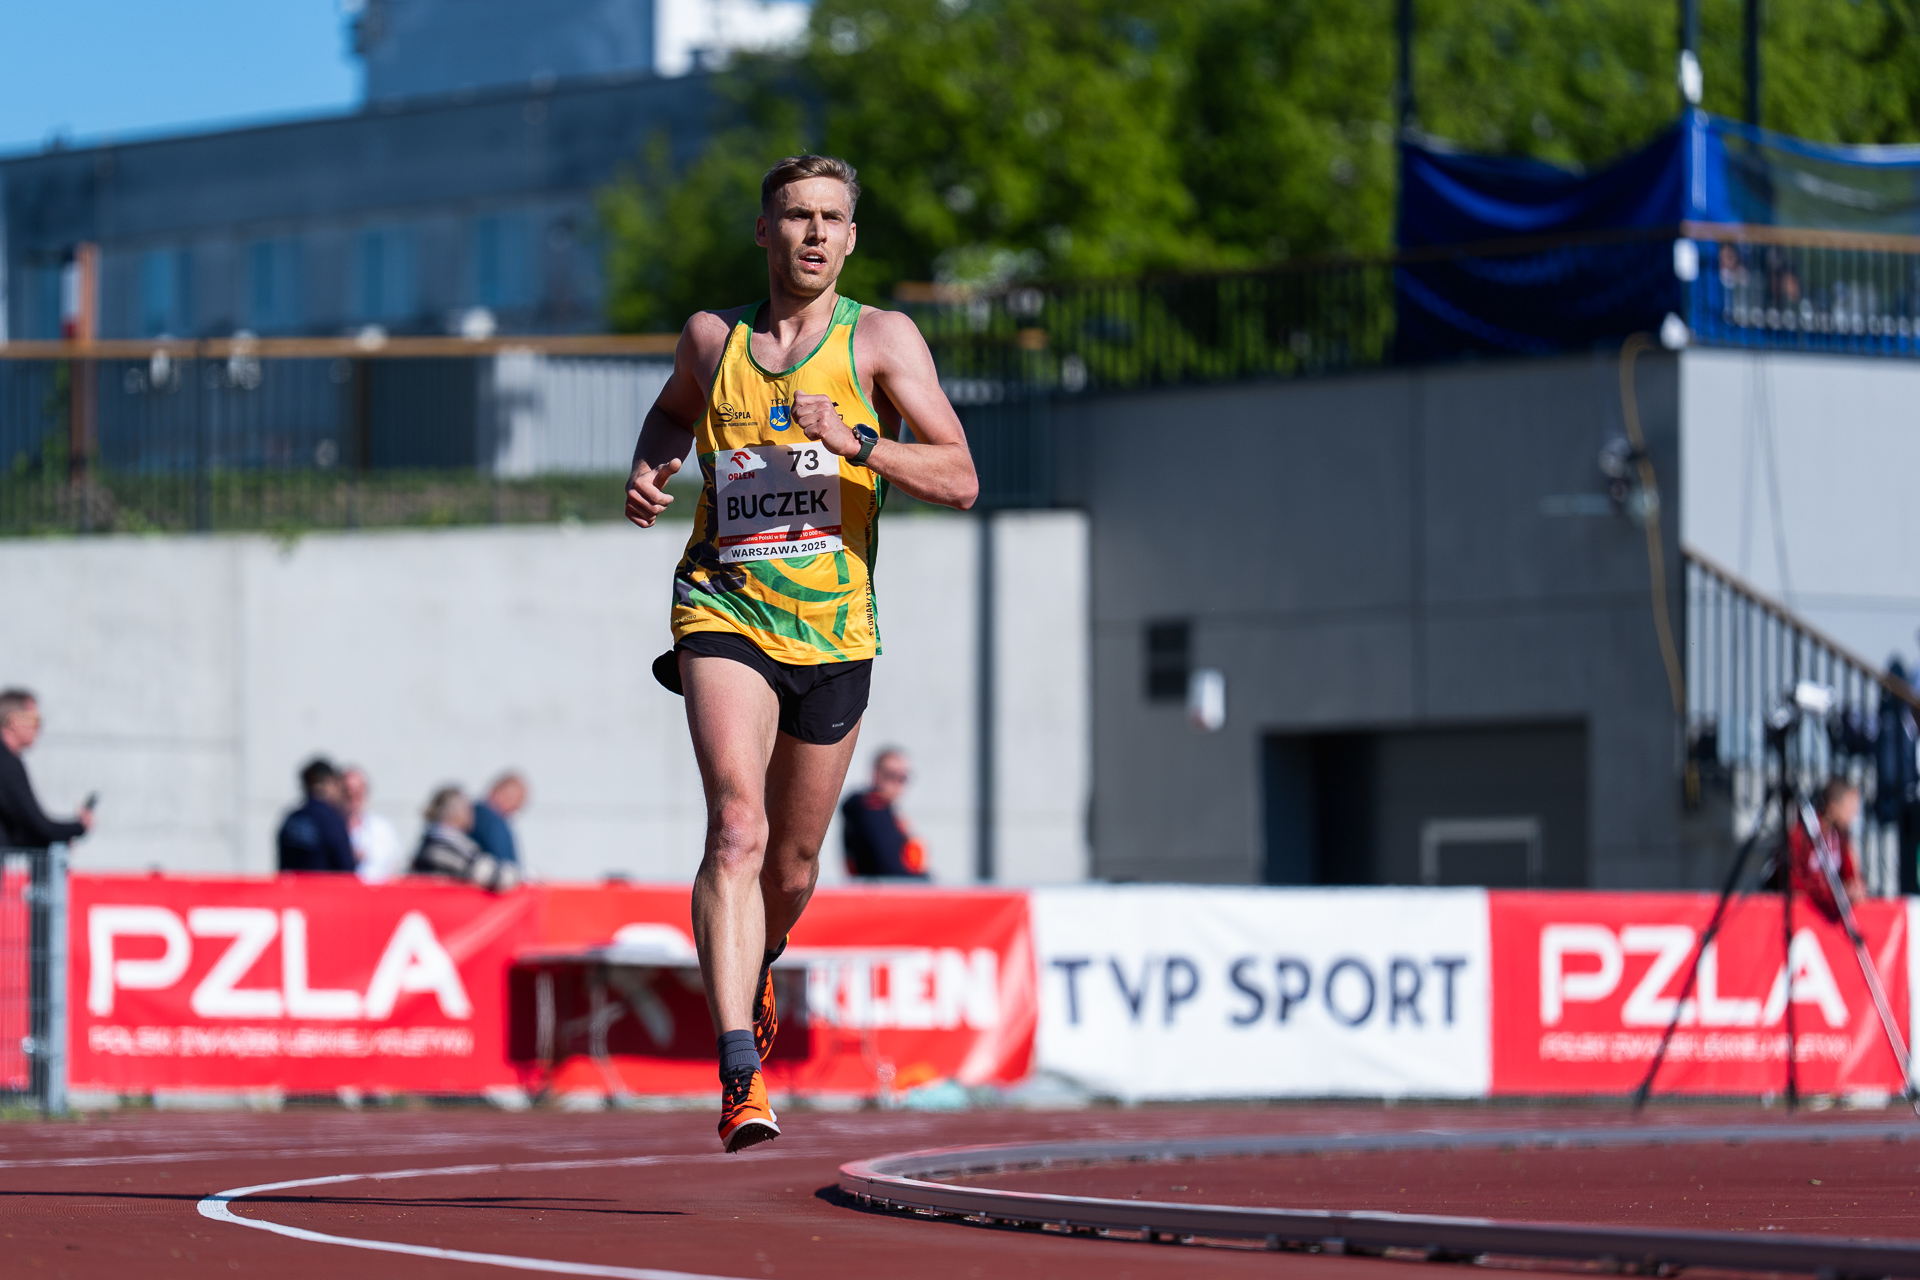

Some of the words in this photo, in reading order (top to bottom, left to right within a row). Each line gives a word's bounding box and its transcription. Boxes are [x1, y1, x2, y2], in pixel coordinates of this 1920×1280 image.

[770, 397, 789, 405] TYCHY
[734, 411, 751, 420] SPLA
[787, 449, 819, 473] 73
[728, 472, 755, 481] ORLEN
[727, 489, 829, 521] BUCZEK
[779, 533, 794, 541] Biegu
[731, 545, 798, 558] WARSZAWA
[801, 540, 827, 552] 2025
[88, 905, 474, 1020] PZLA
[1540, 923, 1849, 1027] PZLA
[1050, 955, 1200, 1027] TVP
[1228, 955, 1468, 1027] SPORT
